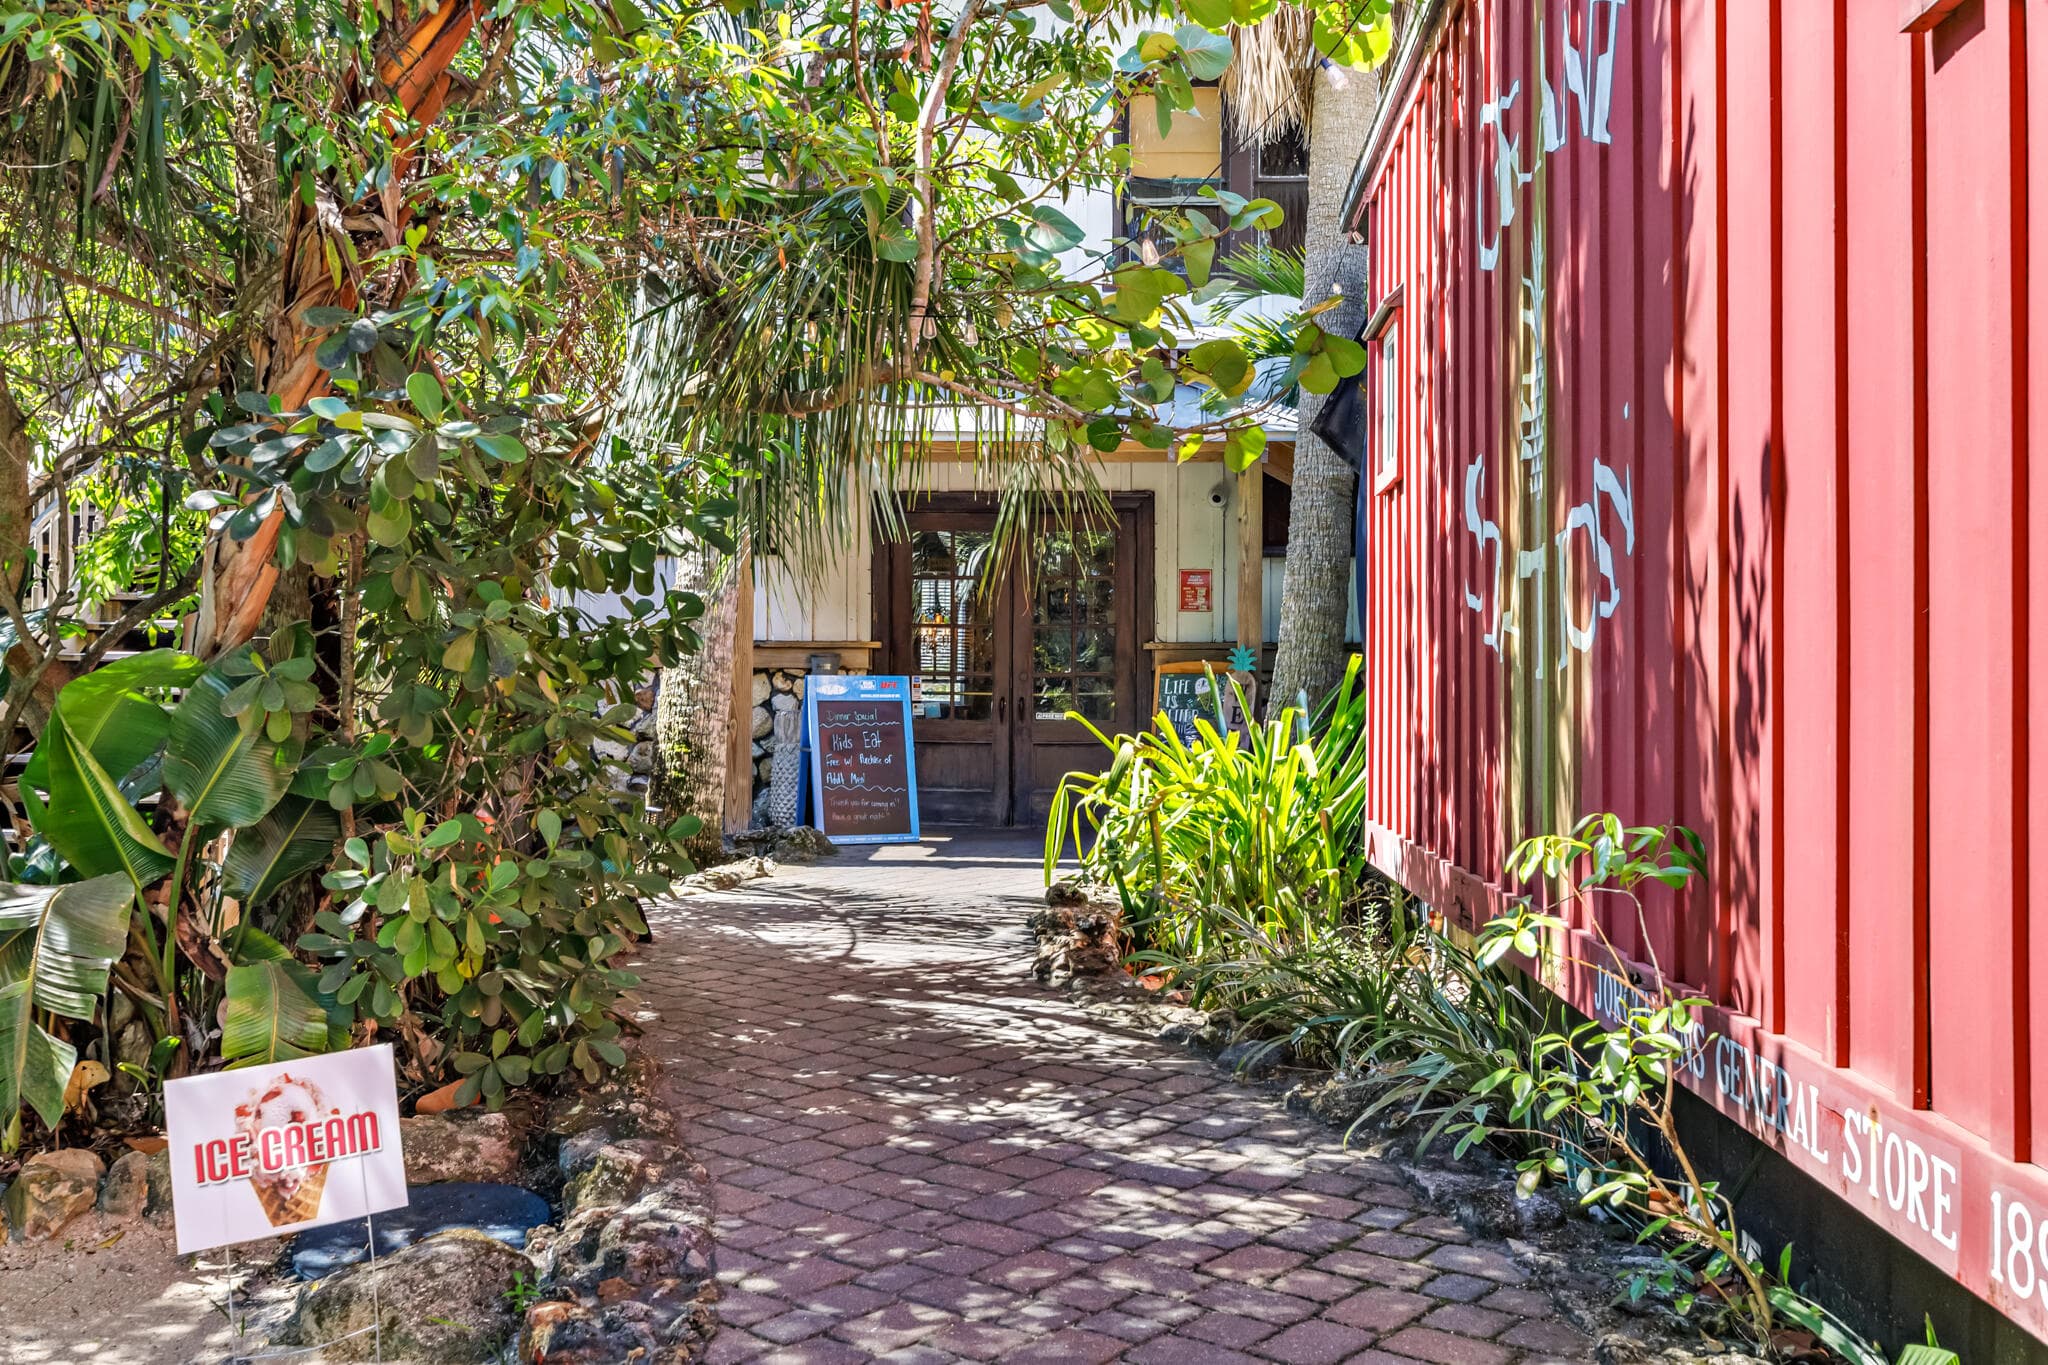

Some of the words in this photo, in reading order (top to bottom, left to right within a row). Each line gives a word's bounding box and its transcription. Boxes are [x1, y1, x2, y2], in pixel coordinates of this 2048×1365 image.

[1164, 678, 1190, 695] LIFE
[1166, 695, 1179, 709] IS
[832, 733, 853, 751] Kids
[862, 730, 882, 748] Eat
[193, 1133, 250, 1185] ICE
[259, 1109, 382, 1172] CREAM
[1715, 1034, 1829, 1164] GENERAL
[1842, 1107, 1957, 1252] STORE
